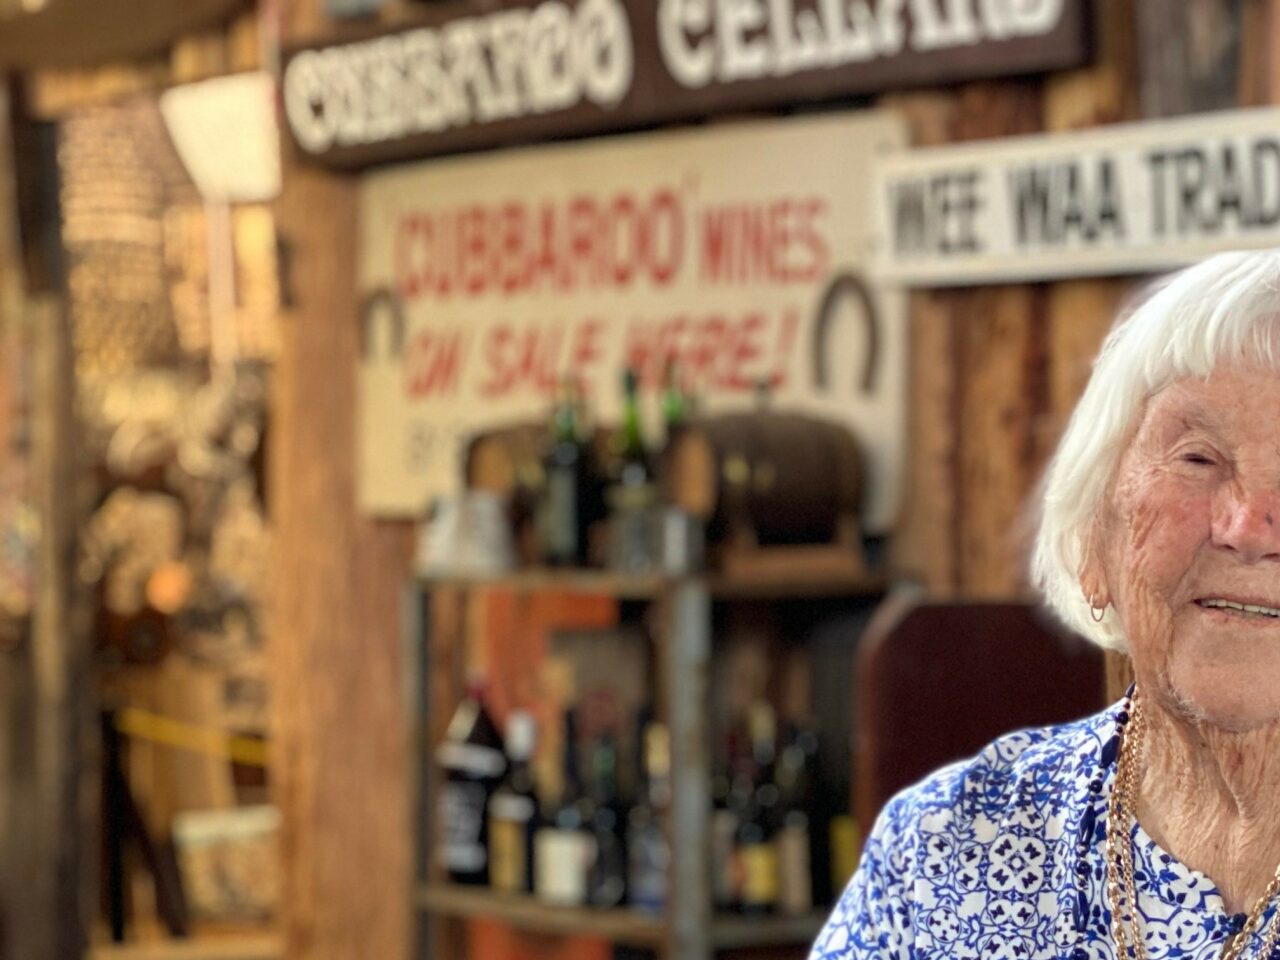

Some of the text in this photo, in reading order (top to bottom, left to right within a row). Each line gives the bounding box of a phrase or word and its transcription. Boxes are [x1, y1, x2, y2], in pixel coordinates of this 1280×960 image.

[701, 198, 831, 286] WINES
[886, 166, 982, 255] WEE
[1008, 148, 1128, 247] WAA
[479, 318, 606, 398] SALE
